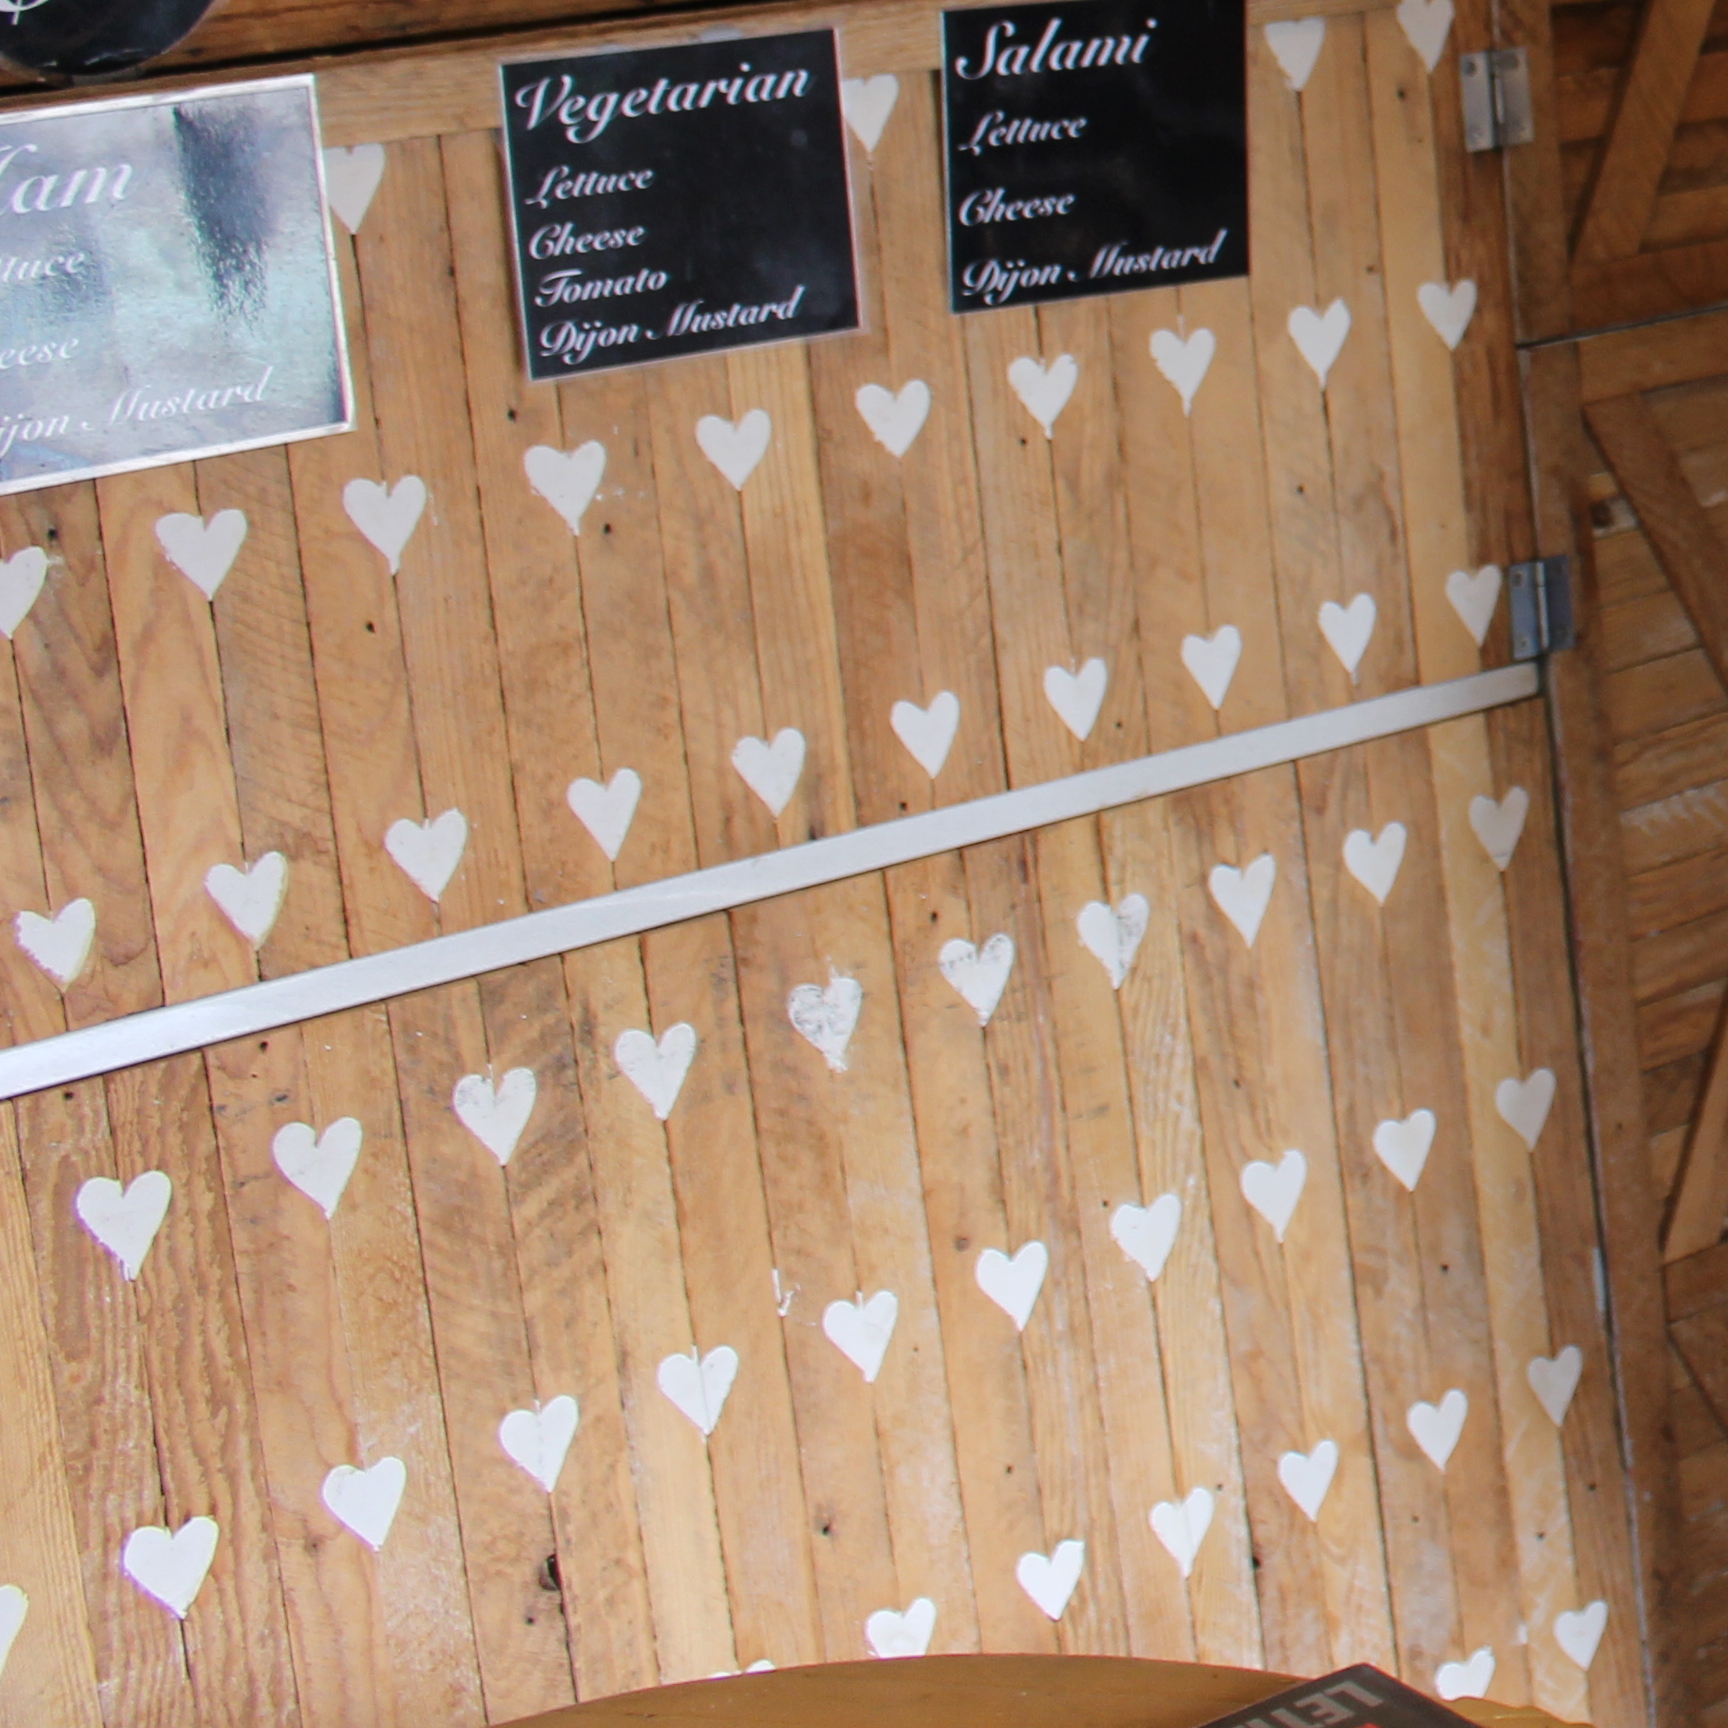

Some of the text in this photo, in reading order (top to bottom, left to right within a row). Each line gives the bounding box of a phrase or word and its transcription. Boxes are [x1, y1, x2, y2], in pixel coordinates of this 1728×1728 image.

[955, 17, 1158, 80] Salami
[514, 62, 810, 145] Vegetarian
[958, 110, 1088, 157] Lettuce
[524, 165, 655, 210] Lettuce
[958, 186, 1076, 227] Cheese
[528, 222, 647, 261] Cheese
[961, 227, 1229, 307] Dijon Mustard
[533, 267, 669, 308] Tomato
[538, 284, 806, 367] Dijon Mustard
[81, 364, 275, 432] Mustard
